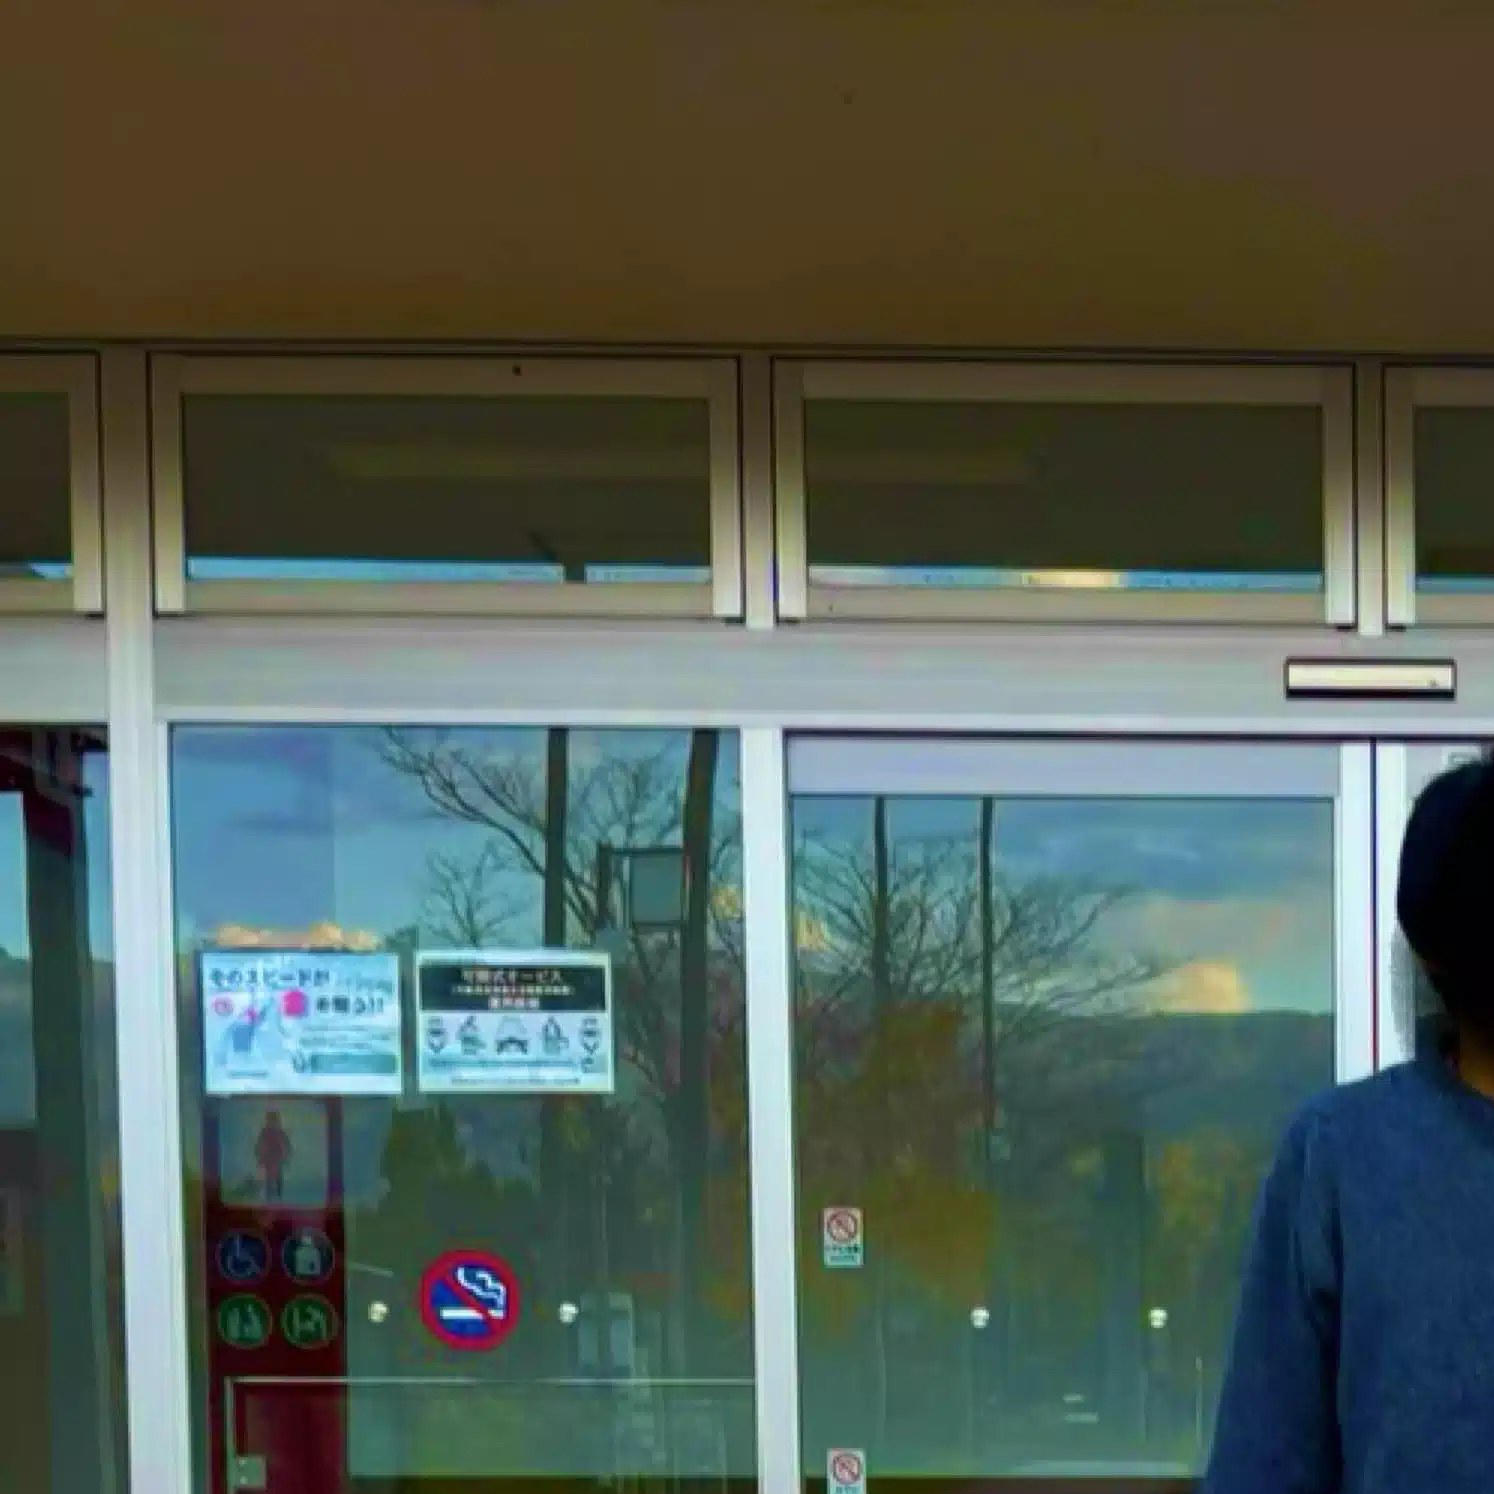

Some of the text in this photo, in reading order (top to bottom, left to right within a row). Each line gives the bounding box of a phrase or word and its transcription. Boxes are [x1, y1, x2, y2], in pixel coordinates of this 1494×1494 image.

[210, 967, 331, 988] そのスピードが
